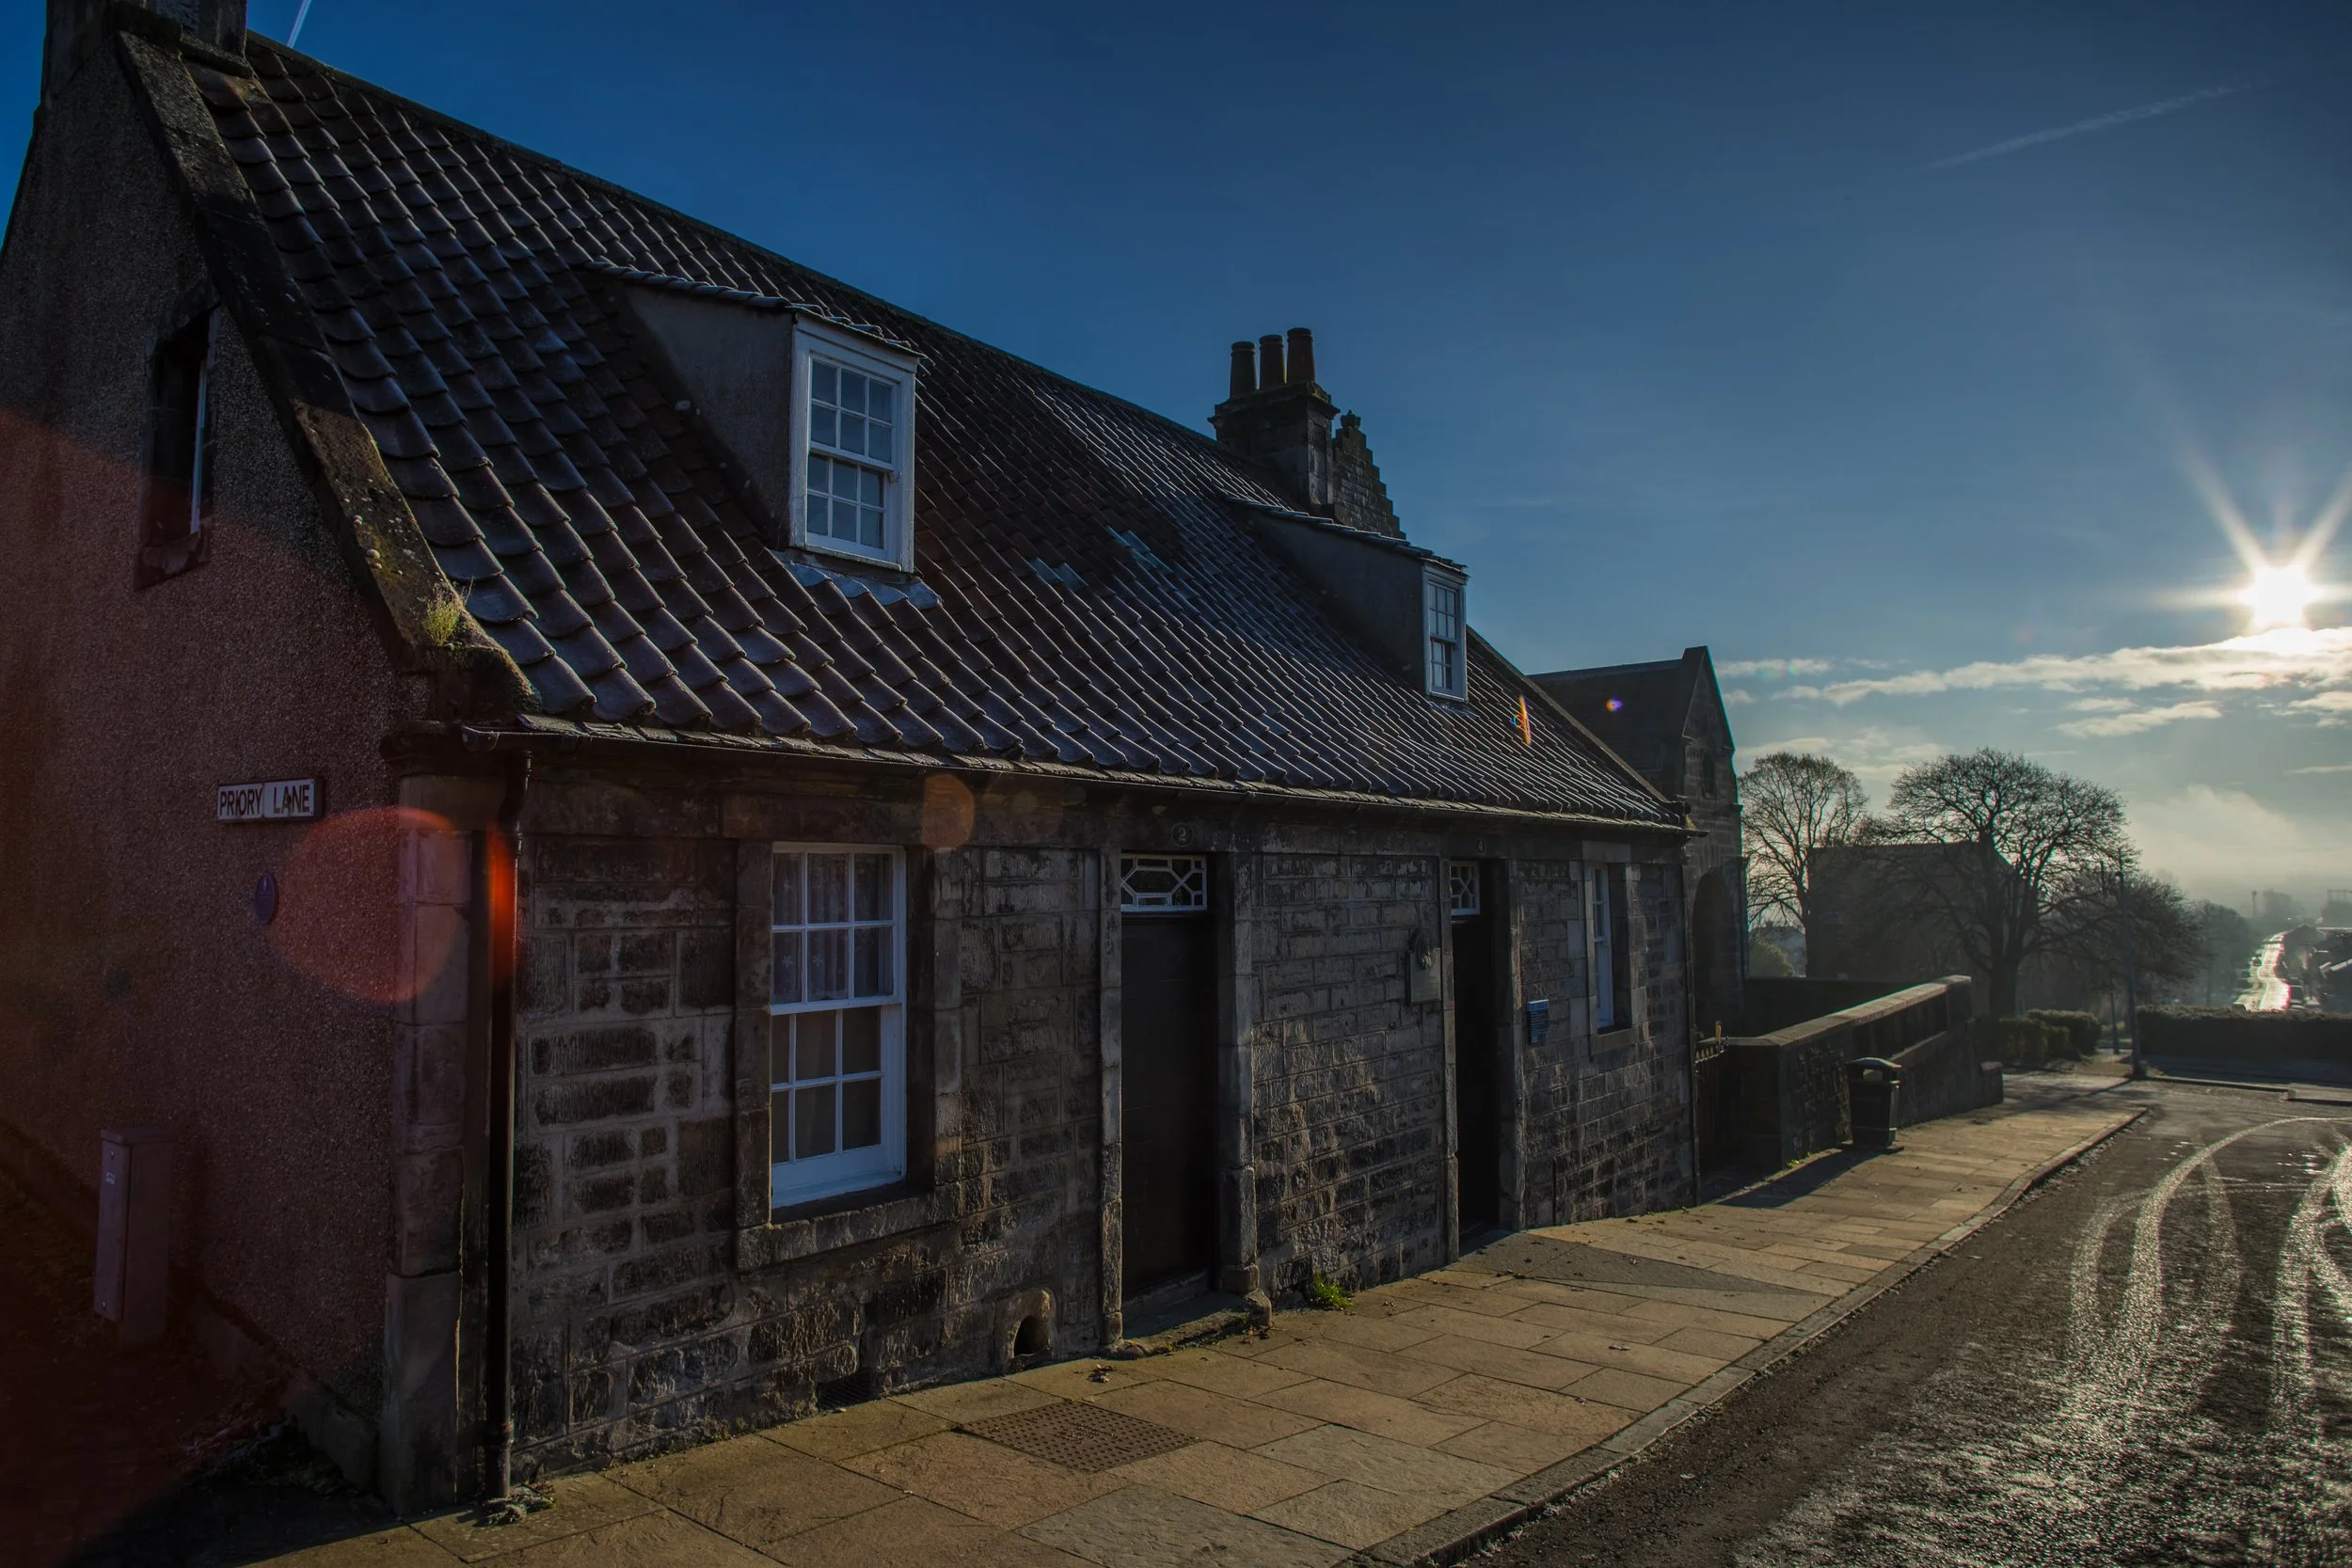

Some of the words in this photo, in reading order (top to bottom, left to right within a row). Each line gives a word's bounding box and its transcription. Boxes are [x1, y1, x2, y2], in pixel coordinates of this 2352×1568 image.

[219, 787, 263, 816] PRIORY
[274, 784, 310, 814] LANE
[1178, 827, 1186, 842] 2
